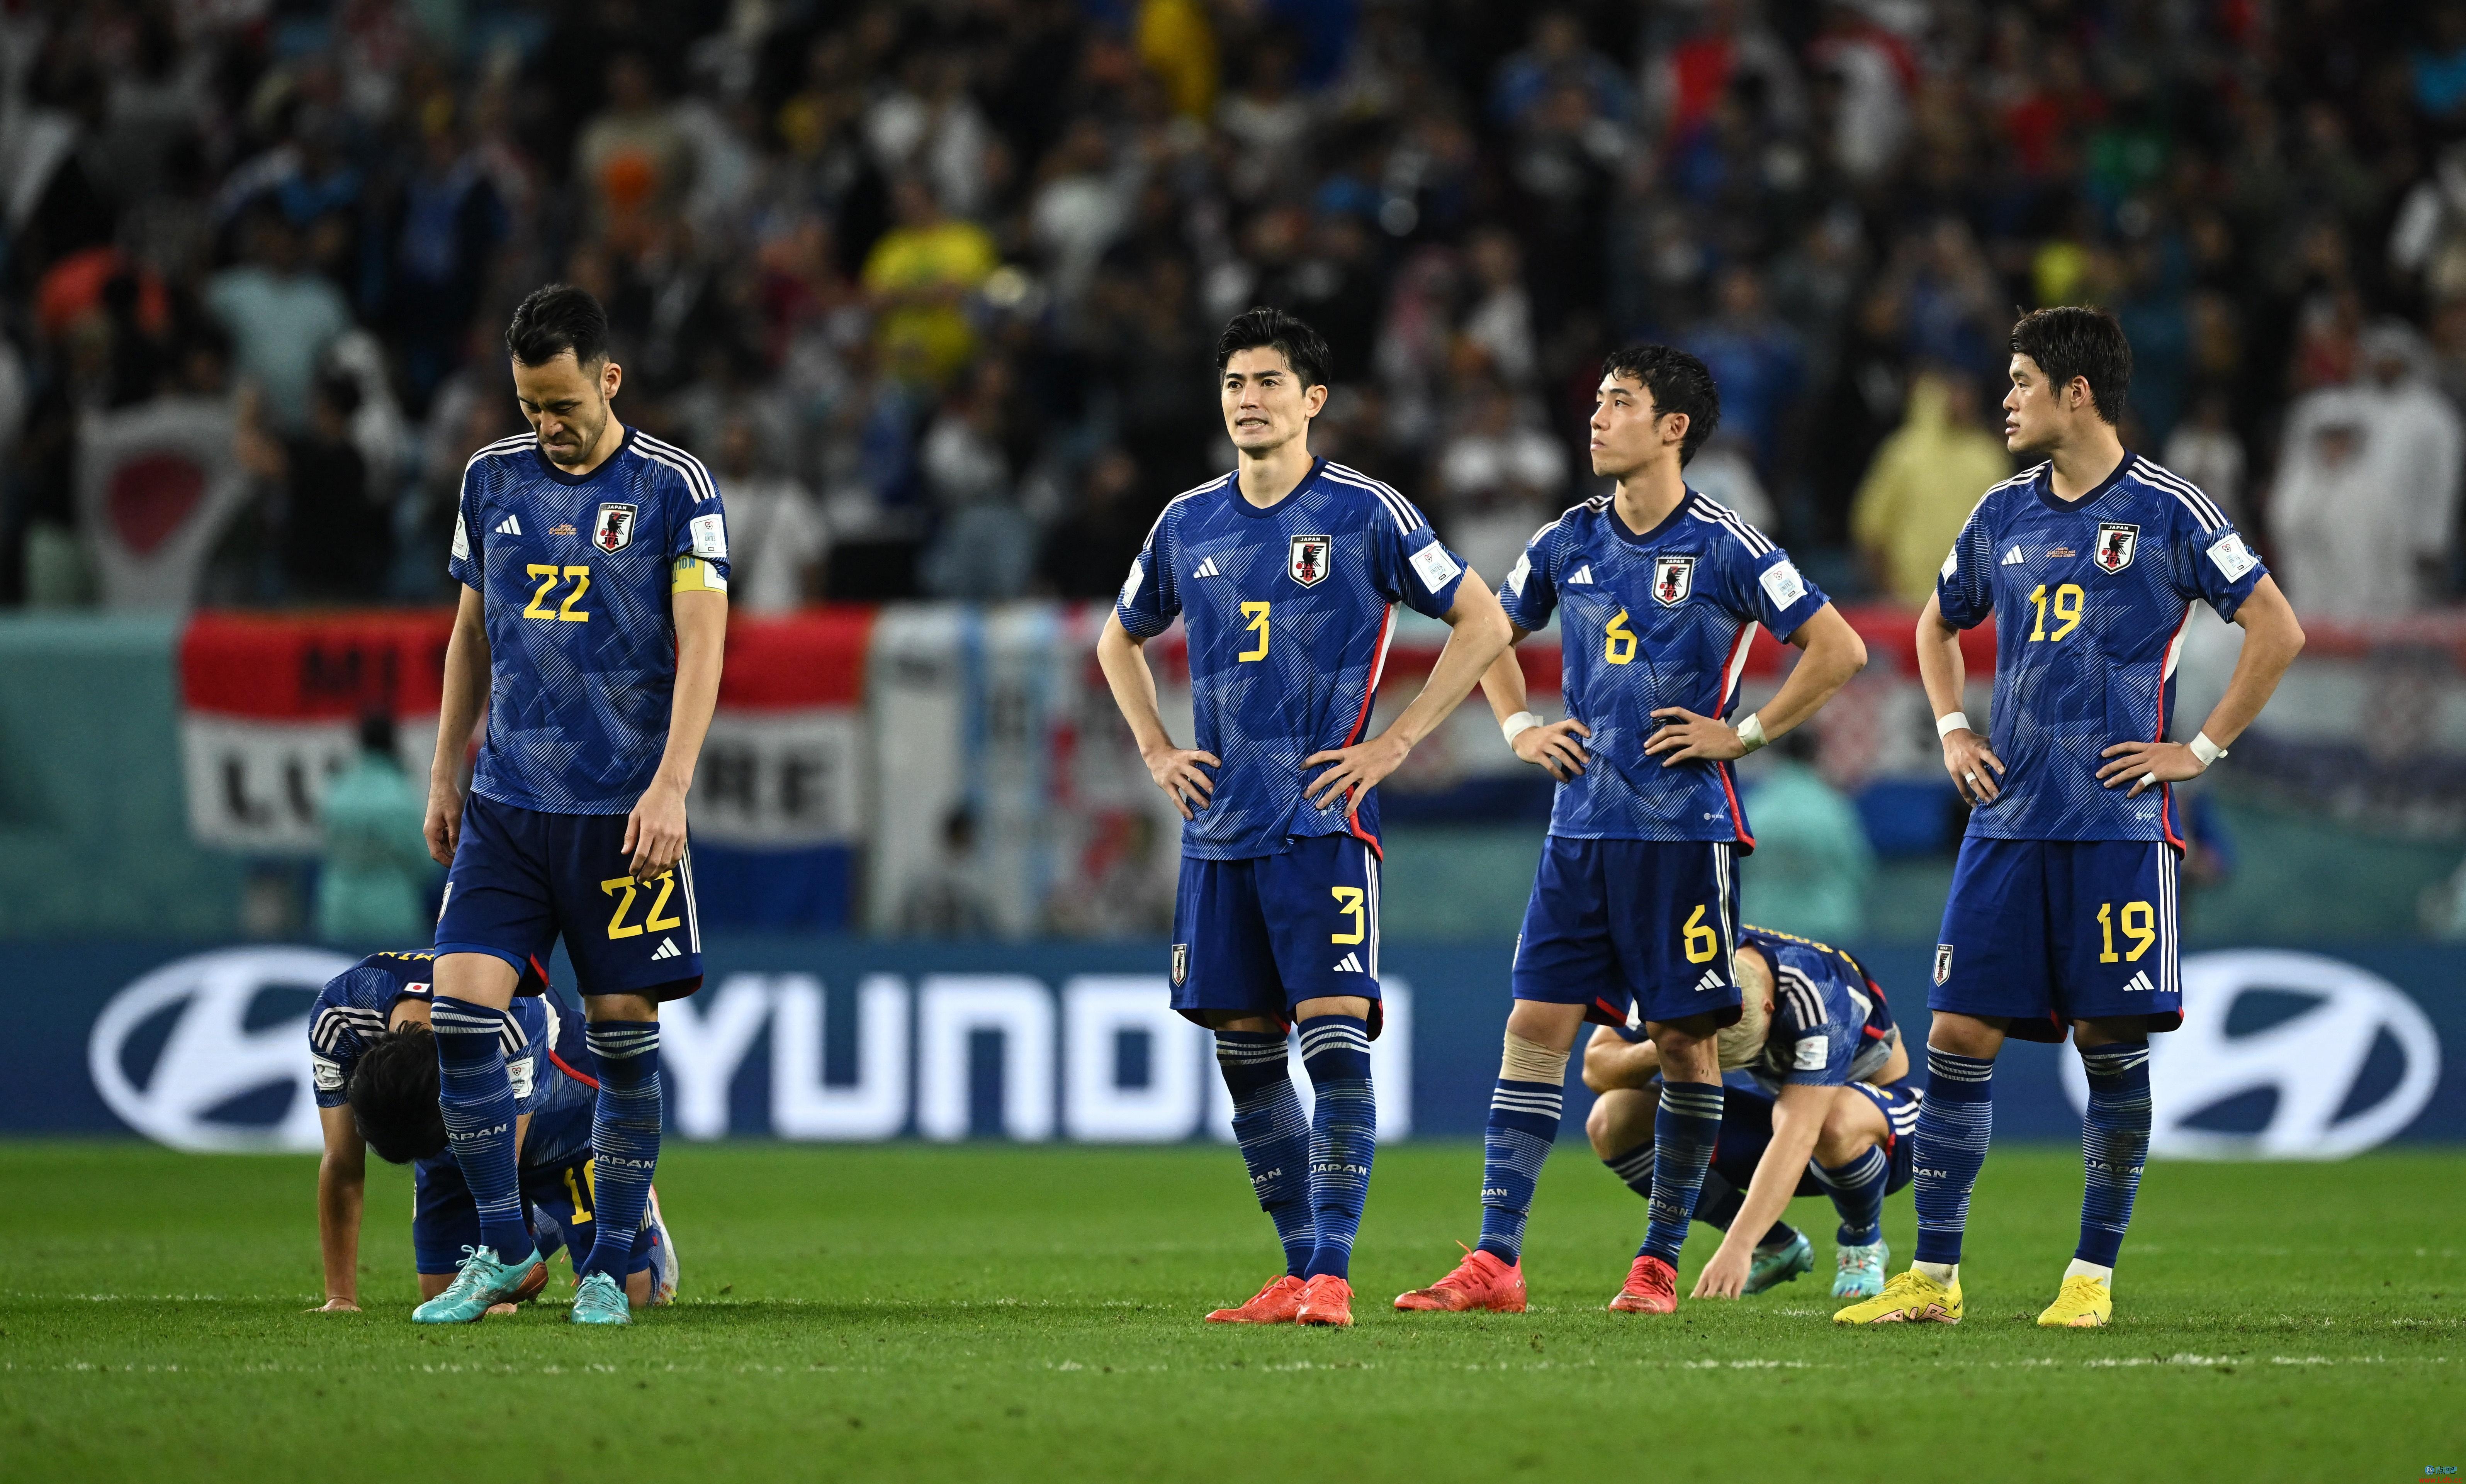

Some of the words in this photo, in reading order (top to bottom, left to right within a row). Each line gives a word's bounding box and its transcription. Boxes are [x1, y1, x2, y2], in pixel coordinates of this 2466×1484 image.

[602, 537, 619, 546] JFA
[1430, 564, 1443, 575] UNITES
[2104, 556, 2121, 565] JFA
[1299, 570, 1316, 578] JFA
[524, 564, 590, 622] 22
[1779, 580, 1793, 592] UNITES
[2029, 584, 2084, 641] 19
[1239, 601, 1270, 662] 3
[1605, 609, 1637, 665] 6
[601, 870, 680, 940] 22
[1332, 886, 1364, 945] 3
[1683, 905, 1717, 964] 6
[2097, 901, 2155, 963] 19
[447, 1123, 507, 1140] APAN
[593, 1152, 654, 1169] JAPAN
[1310, 1163, 1367, 1175] JAPAN
[2088, 1160, 2144, 1174] JAPAN
[1481, 1188, 1507, 1197] PAN
[1649, 1197, 1689, 1216] APAN
[1870, 1303, 1961, 1323] AIR
